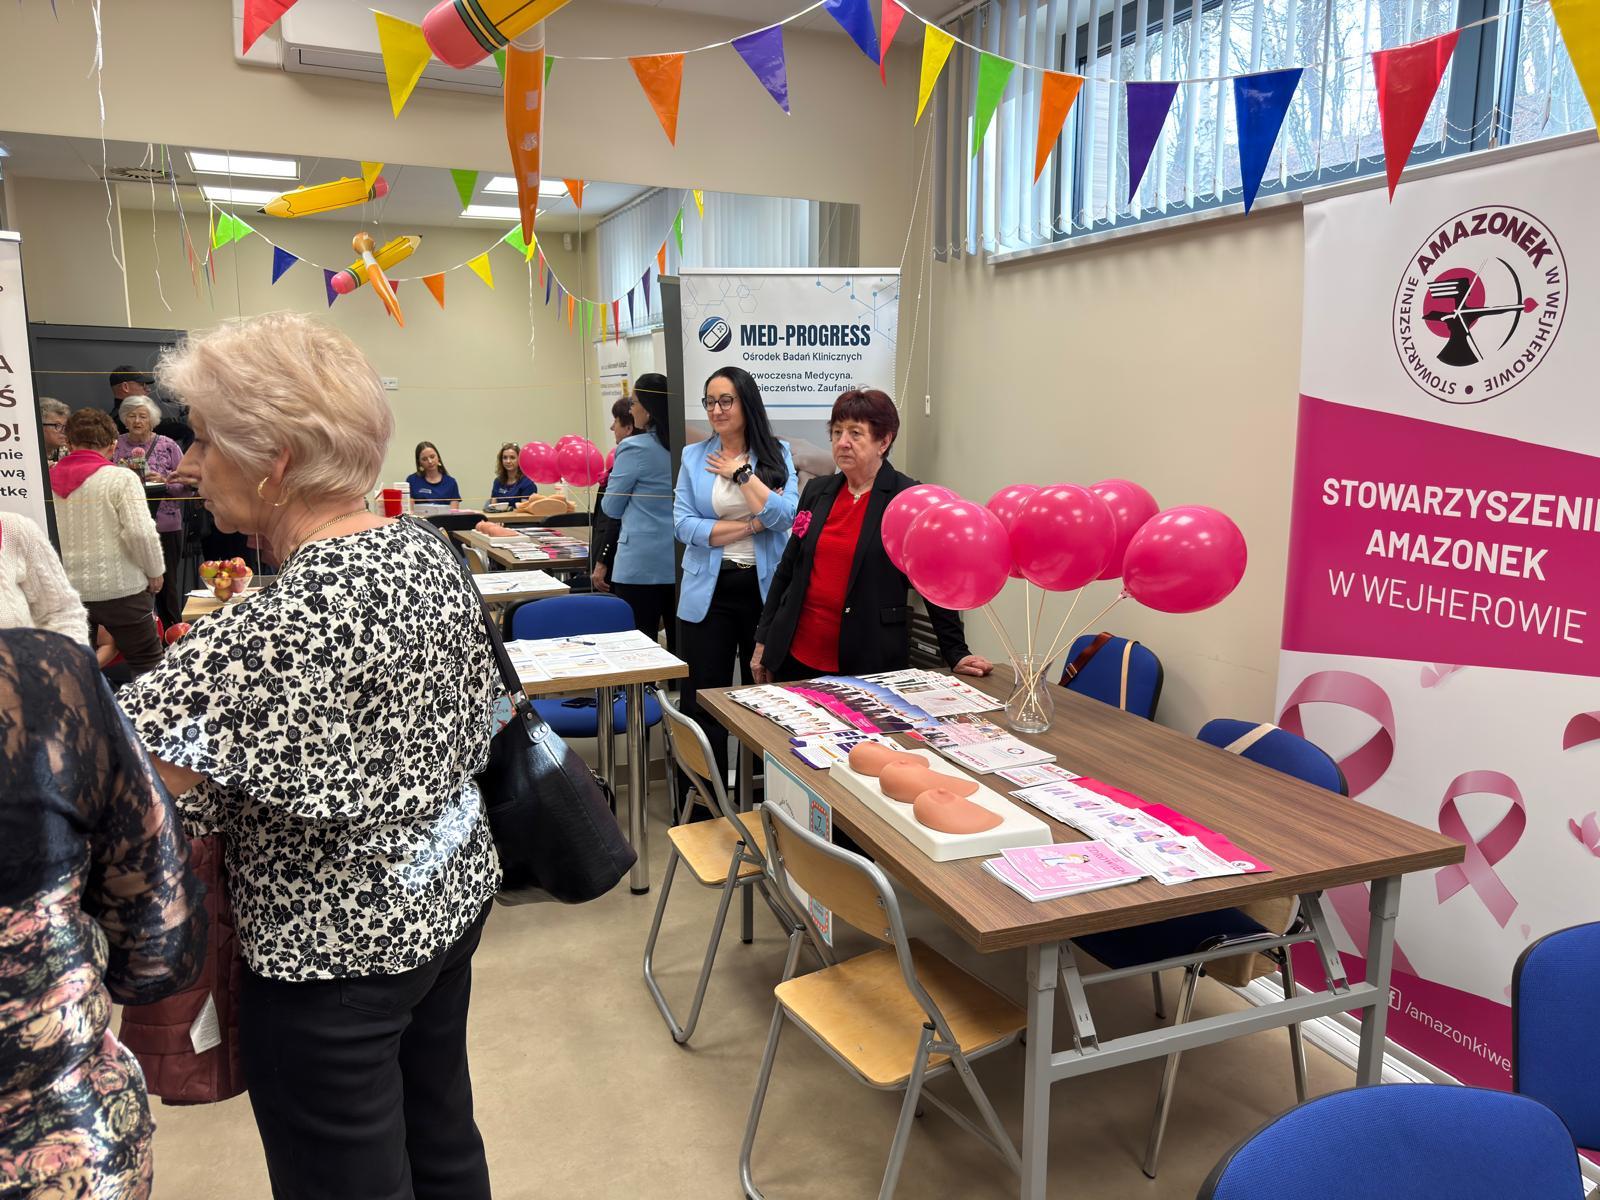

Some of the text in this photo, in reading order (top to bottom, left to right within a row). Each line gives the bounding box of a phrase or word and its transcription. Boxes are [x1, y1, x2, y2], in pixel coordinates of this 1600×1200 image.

[1399, 212, 1560, 395] STOWARZYSZENIE AMAZONEK W WEJHEROWIE
[740, 324, 871, 347] MED-PROGRESS
[742, 352, 862, 362] Ośrodek Badań Klinicznych
[750, 371, 853, 381] owoczesna Medycyna.
[1365, 528, 1549, 581] AMAZONEK
[1328, 569, 1587, 644] W WEJHEROWIE
[1405, 1001, 1513, 1079] /amazonkiwe
